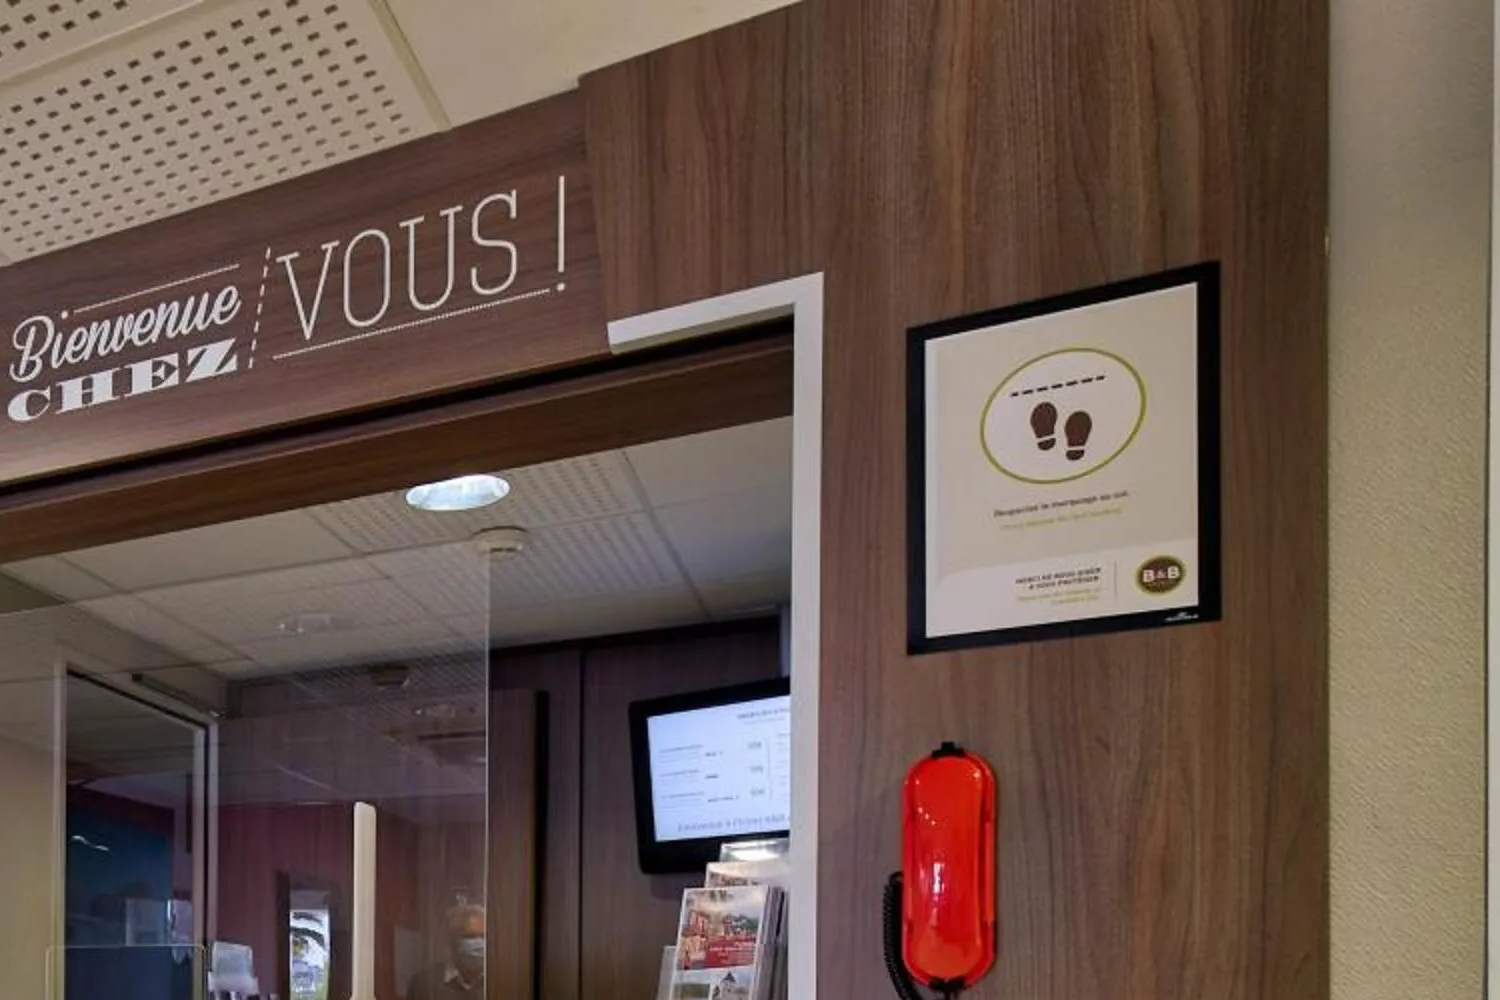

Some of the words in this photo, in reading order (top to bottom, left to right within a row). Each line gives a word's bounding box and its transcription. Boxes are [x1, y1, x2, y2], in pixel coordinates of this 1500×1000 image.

[275, 189, 519, 341] VOUS
[7, 337, 239, 422] CHEZ
[8, 284, 242, 383] Bienvenue
